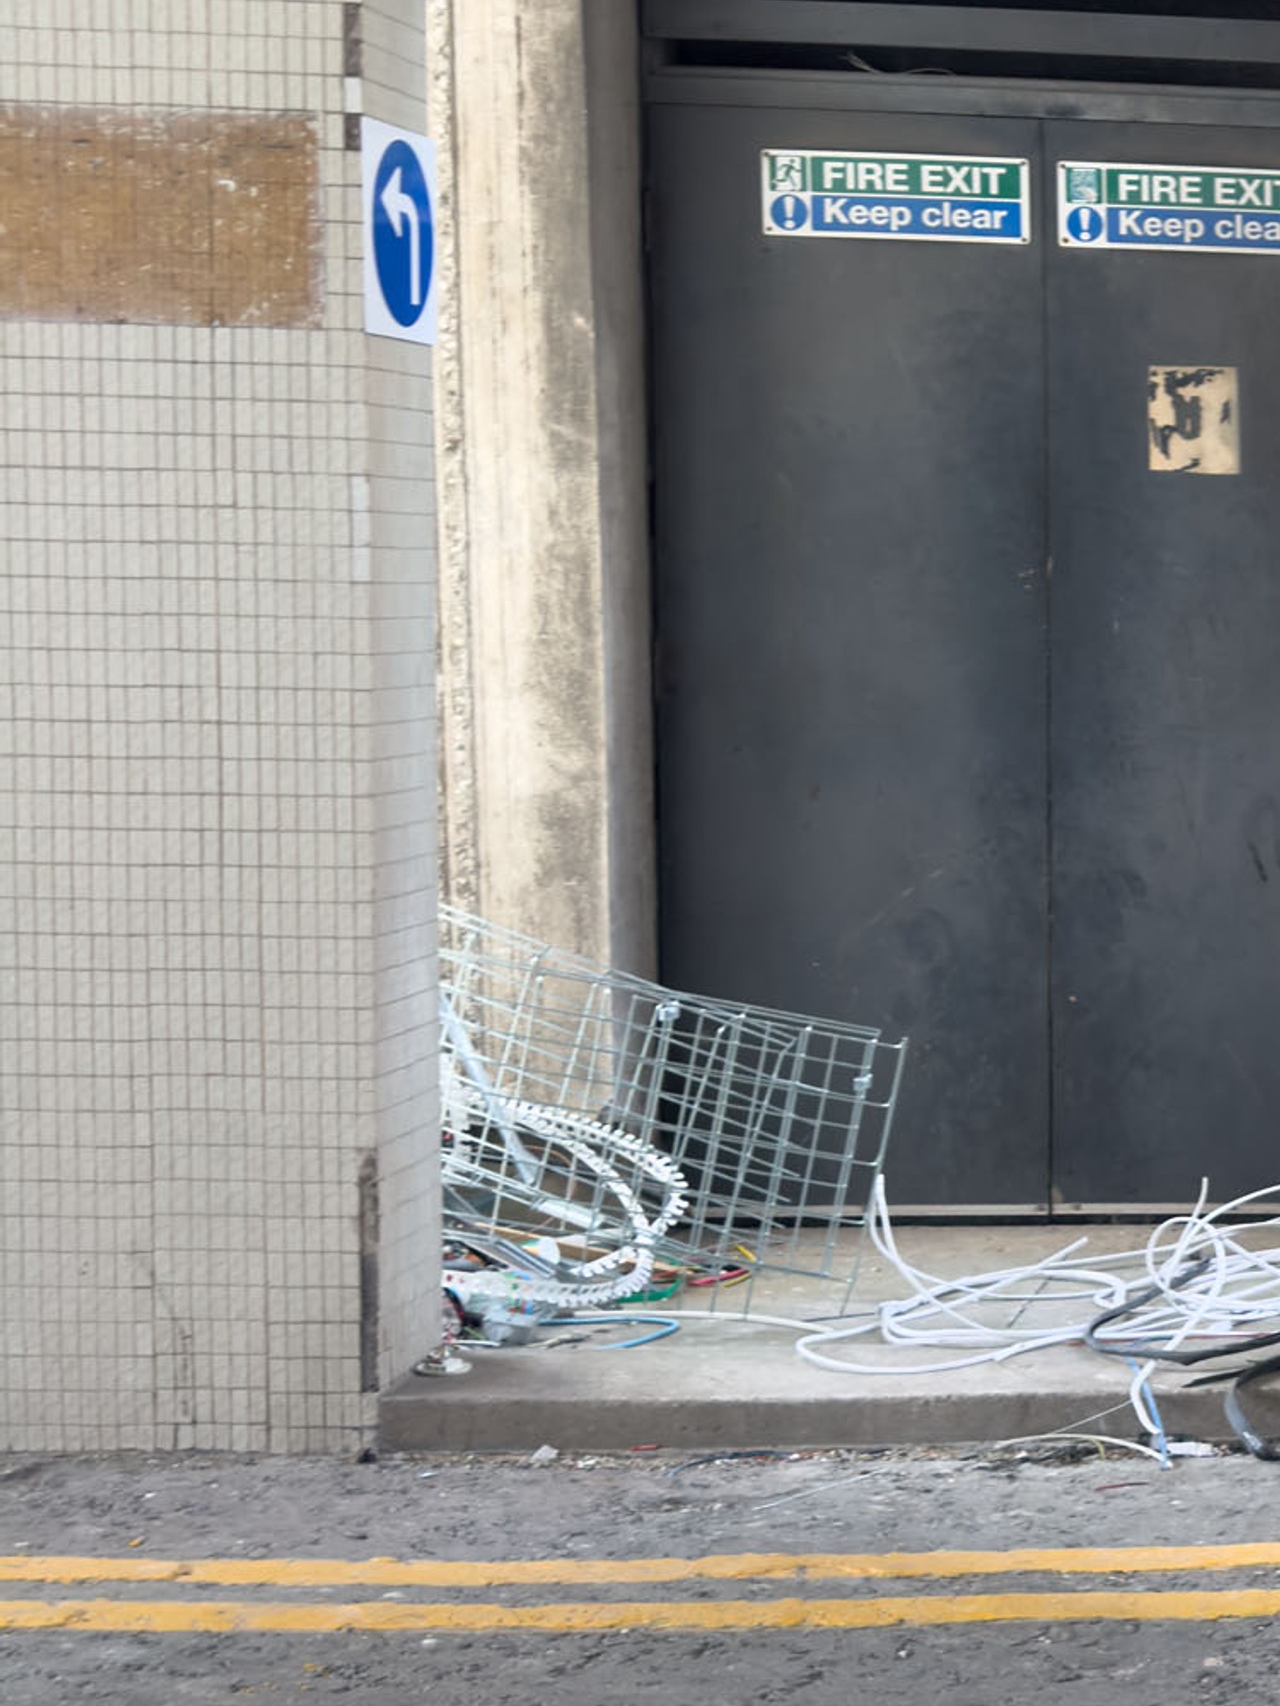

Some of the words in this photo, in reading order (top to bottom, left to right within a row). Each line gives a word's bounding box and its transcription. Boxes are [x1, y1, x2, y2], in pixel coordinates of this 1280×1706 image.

[823, 162, 909, 192] FIRE
[921, 166, 1006, 195] EXIT
[1118, 174, 1203, 204] FIRE
[824, 199, 912, 230] Keep
[922, 202, 1007, 229] clear
[1119, 210, 1205, 242] Keep
